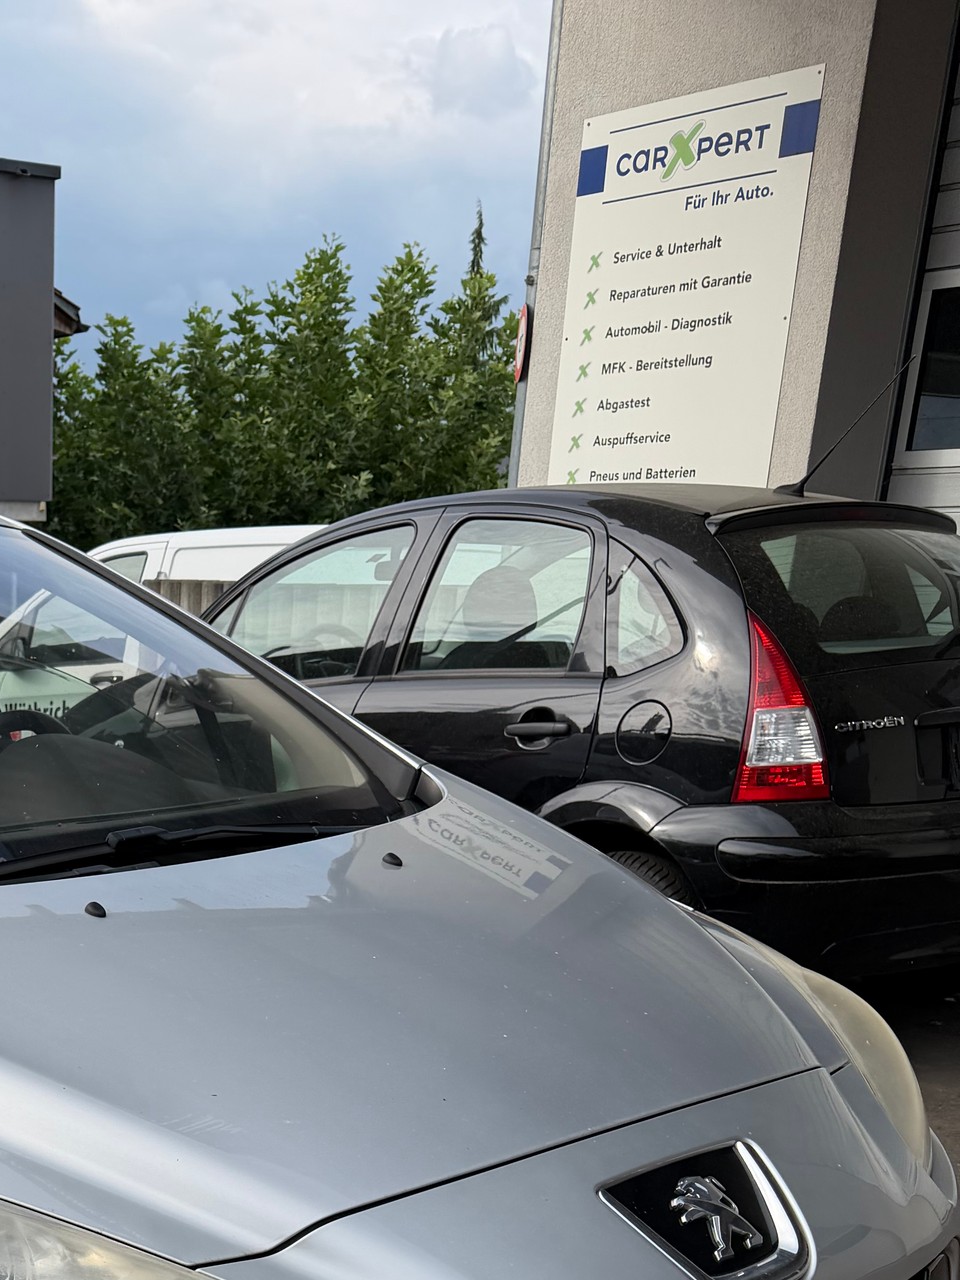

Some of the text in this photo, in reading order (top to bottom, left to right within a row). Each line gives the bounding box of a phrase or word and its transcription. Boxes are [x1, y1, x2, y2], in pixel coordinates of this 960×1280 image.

[684, 183, 775, 211] Für Ihr Auto.
[613, 235, 723, 264] Service & Unterhalt
[609, 270, 752, 303] Reparaturen mit Garantie
[605, 320, 661, 339] Automobil
[671, 311, 732, 331] Diagnostik
[601, 361, 626, 375] MFK
[636, 354, 713, 373] Bereitstellung
[596, 396, 651, 413] Abgastest
[593, 431, 671, 449] Auspuffservice
[589, 467, 696, 482] Pneus und Batterien
[5, 700, 69, 718] Wthrich
[834, 715, 905, 732] CITROËN
